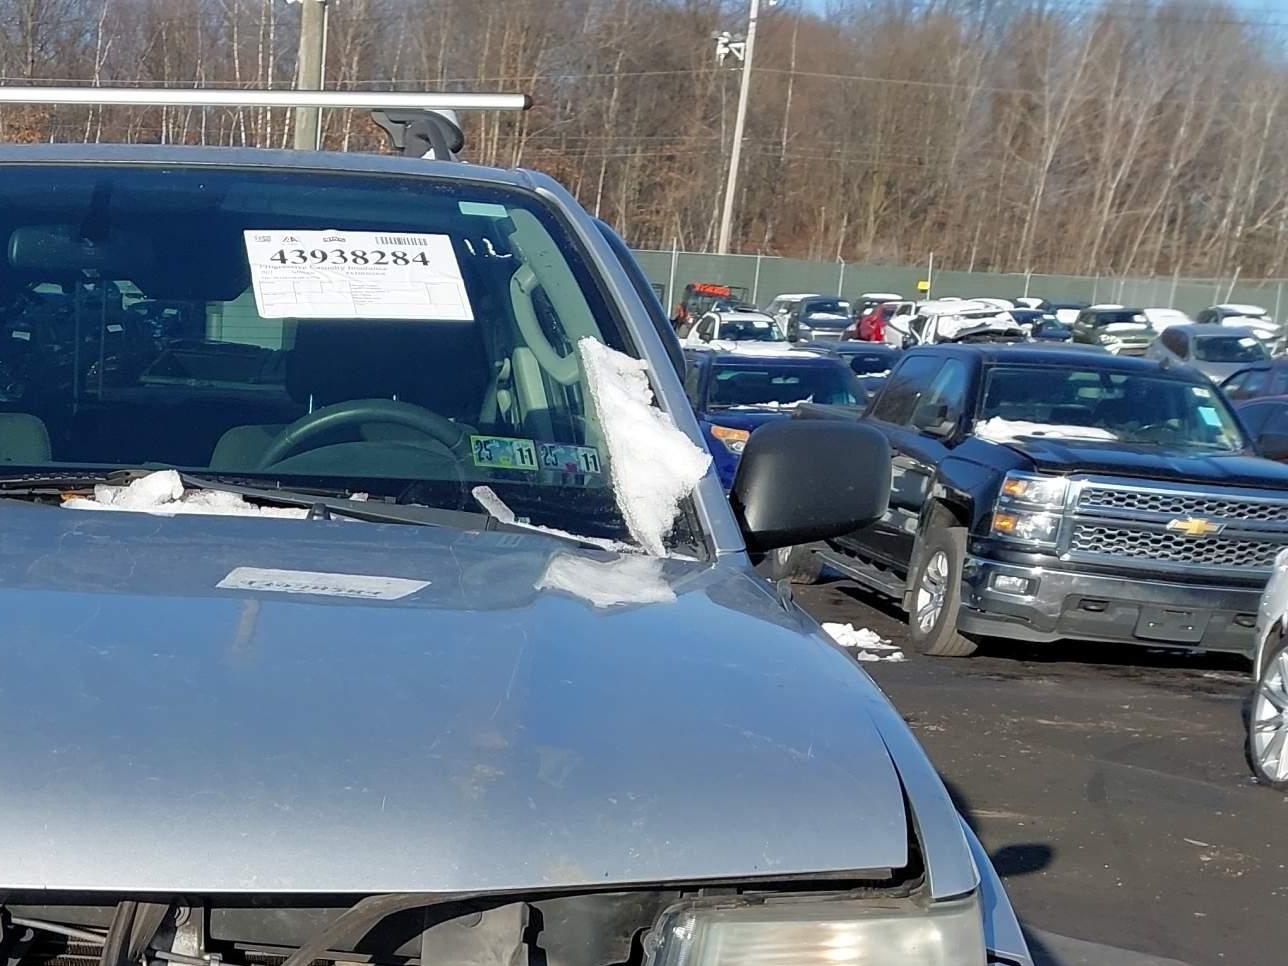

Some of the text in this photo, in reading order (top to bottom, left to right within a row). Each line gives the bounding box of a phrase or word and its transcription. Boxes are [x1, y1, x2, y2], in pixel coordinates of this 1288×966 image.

[270, 249, 430, 266] 43938284
[475, 440, 534, 465] 25 11
[542, 446, 599, 472] 25 11
